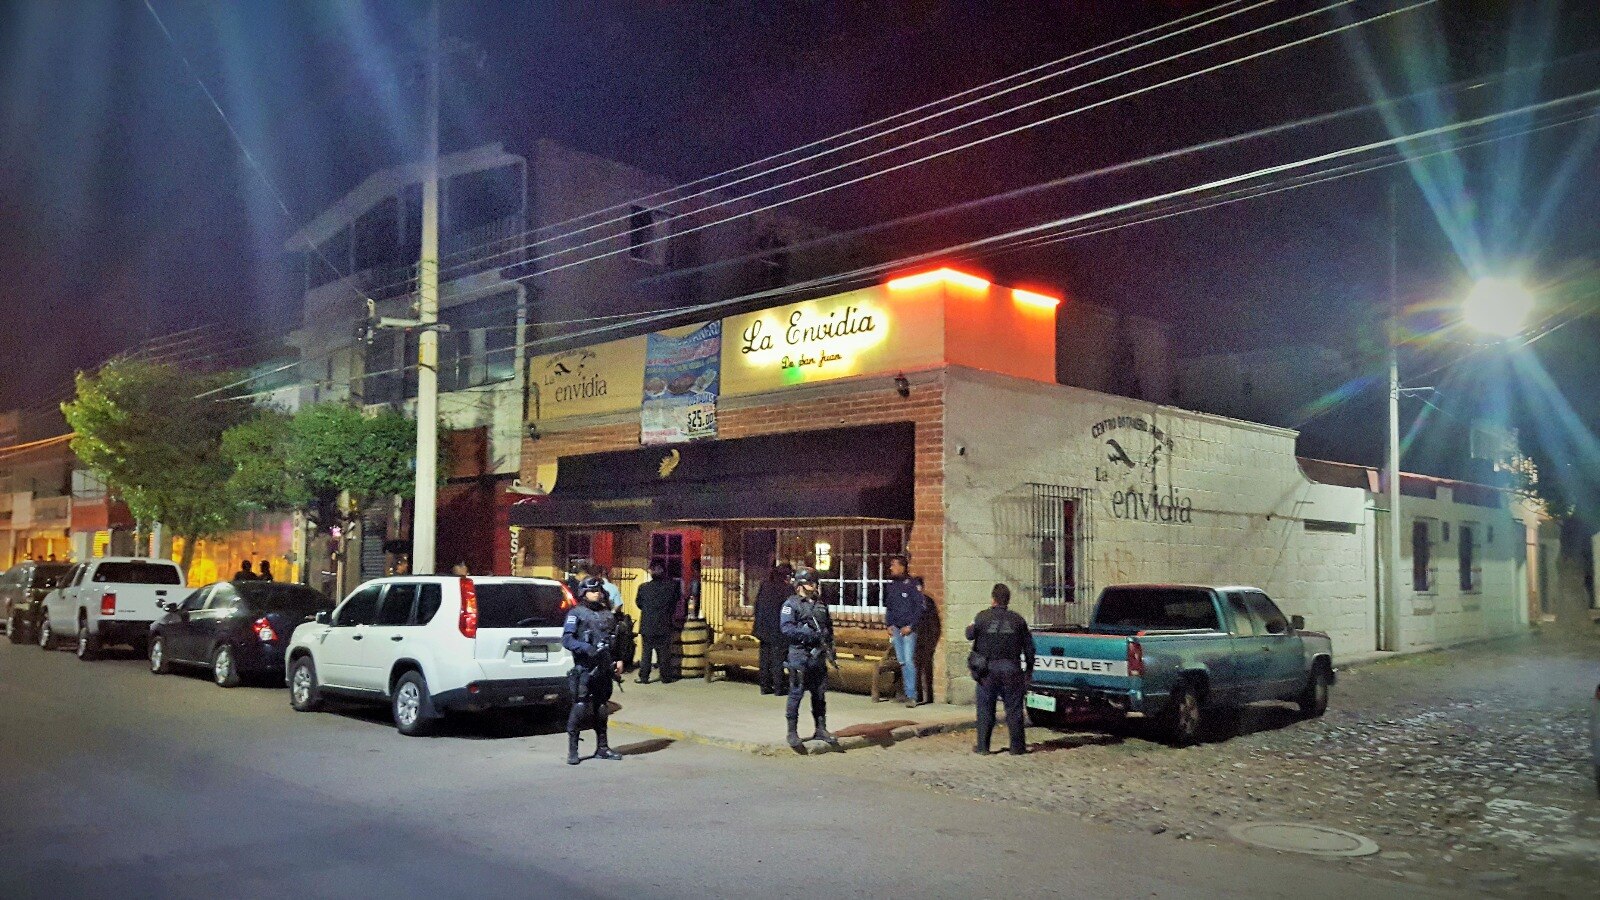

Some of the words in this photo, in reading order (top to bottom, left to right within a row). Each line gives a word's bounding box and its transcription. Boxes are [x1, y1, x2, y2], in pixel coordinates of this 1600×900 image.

[742, 319, 774, 354] La
[786, 306, 875, 345] Envidia
[555, 373, 608, 402] envidia
[687, 409, 714, 428] $25.00
[1095, 466, 1108, 482] La
[1111, 485, 1193, 523] envidia
[1034, 658, 1114, 673] EVROLET
